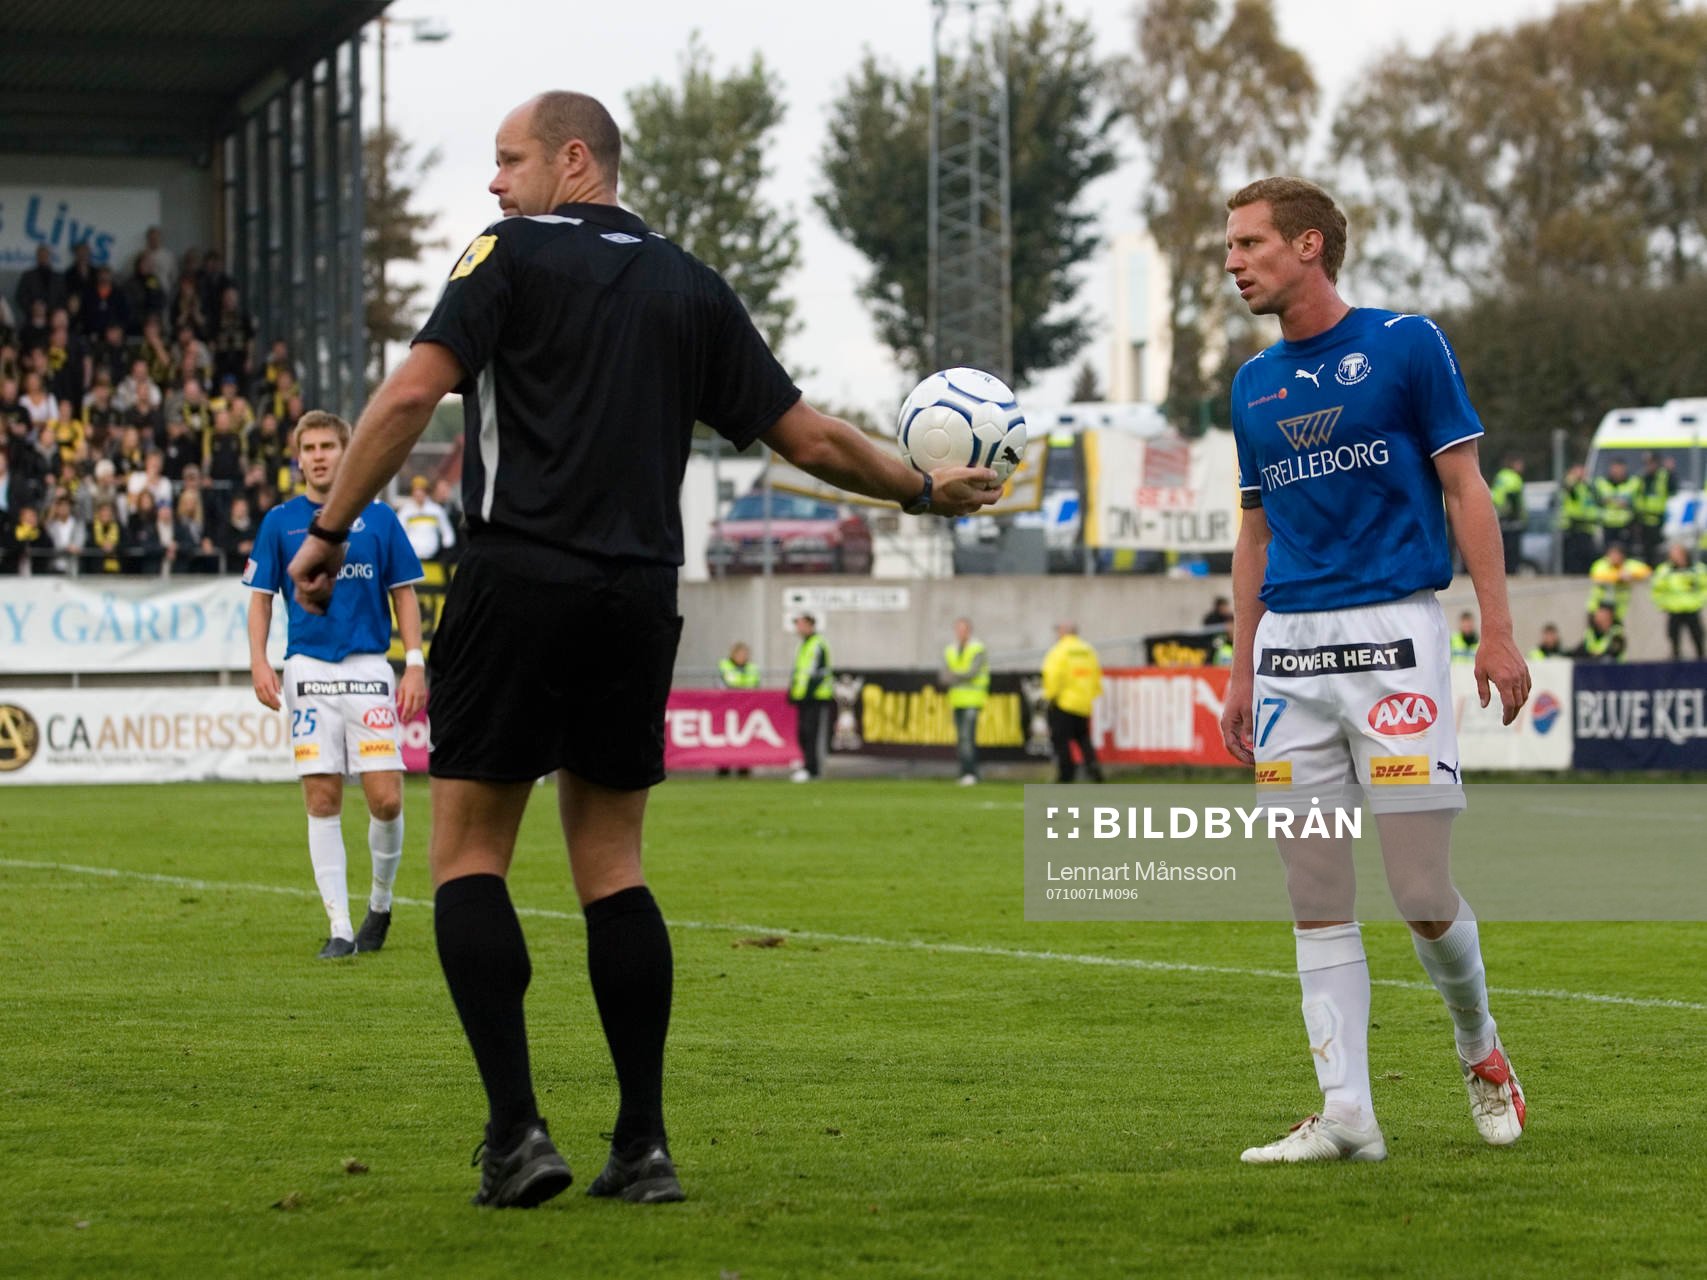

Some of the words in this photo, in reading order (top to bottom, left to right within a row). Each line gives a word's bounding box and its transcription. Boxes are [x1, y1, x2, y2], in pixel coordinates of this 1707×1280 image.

[1262, 440, 1390, 492] TRELLEBORG
[51, 591, 207, 645] GÅRD
[1271, 651, 1338, 673] POWER
[1344, 648, 1399, 668] HEAT
[303, 682, 347, 694] POWER
[350, 682, 383, 693] HEAT
[292, 708, 317, 738] 25
[367, 707, 396, 729] AXA
[665, 708, 785, 748] ELIA
[1091, 675, 1194, 749] PUMA
[1374, 696, 1433, 729] AXA
[1574, 688, 1648, 739] BLUE
[1375, 763, 1416, 778] DHL
